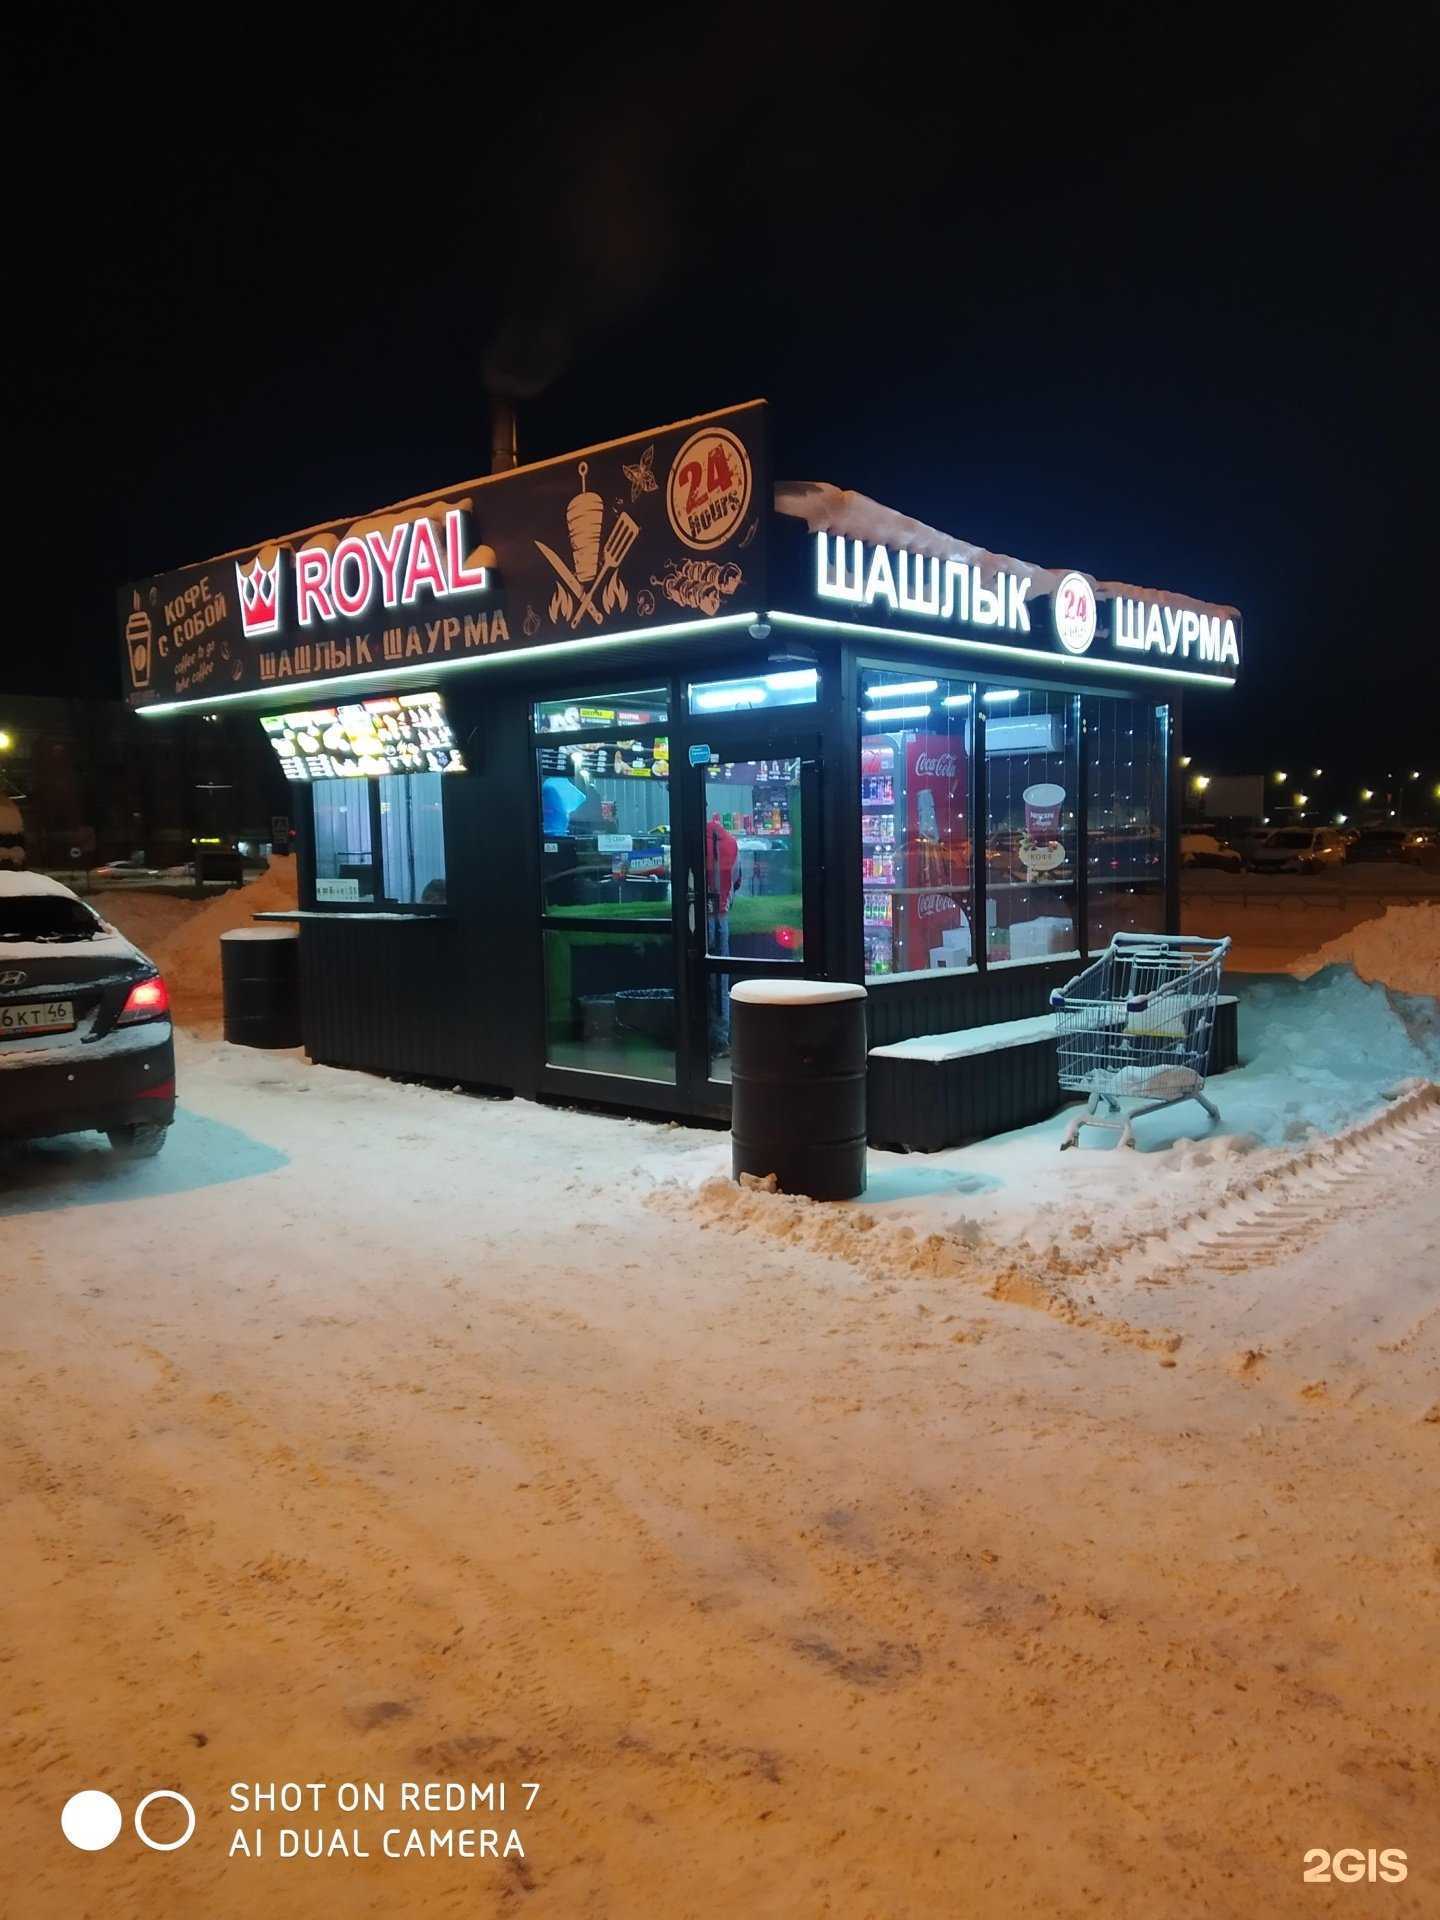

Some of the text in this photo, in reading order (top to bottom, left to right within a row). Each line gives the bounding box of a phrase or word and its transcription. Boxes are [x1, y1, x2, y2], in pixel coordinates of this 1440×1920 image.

[678, 442, 734, 515] 24
[164, 576, 211, 626] КОФЕ
[295, 509, 487, 626] ROYAL
[816, 530, 1032, 632] ШАШЛЫК
[158, 592, 228, 657] С СОБОЙ
[1064, 589, 1087, 622] 24
[1115, 595, 1240, 665] ШАУРМА
[259, 609, 511, 681] ШАШЛЫК ШАУРМА
[47, 1003, 67, 1018] 46
